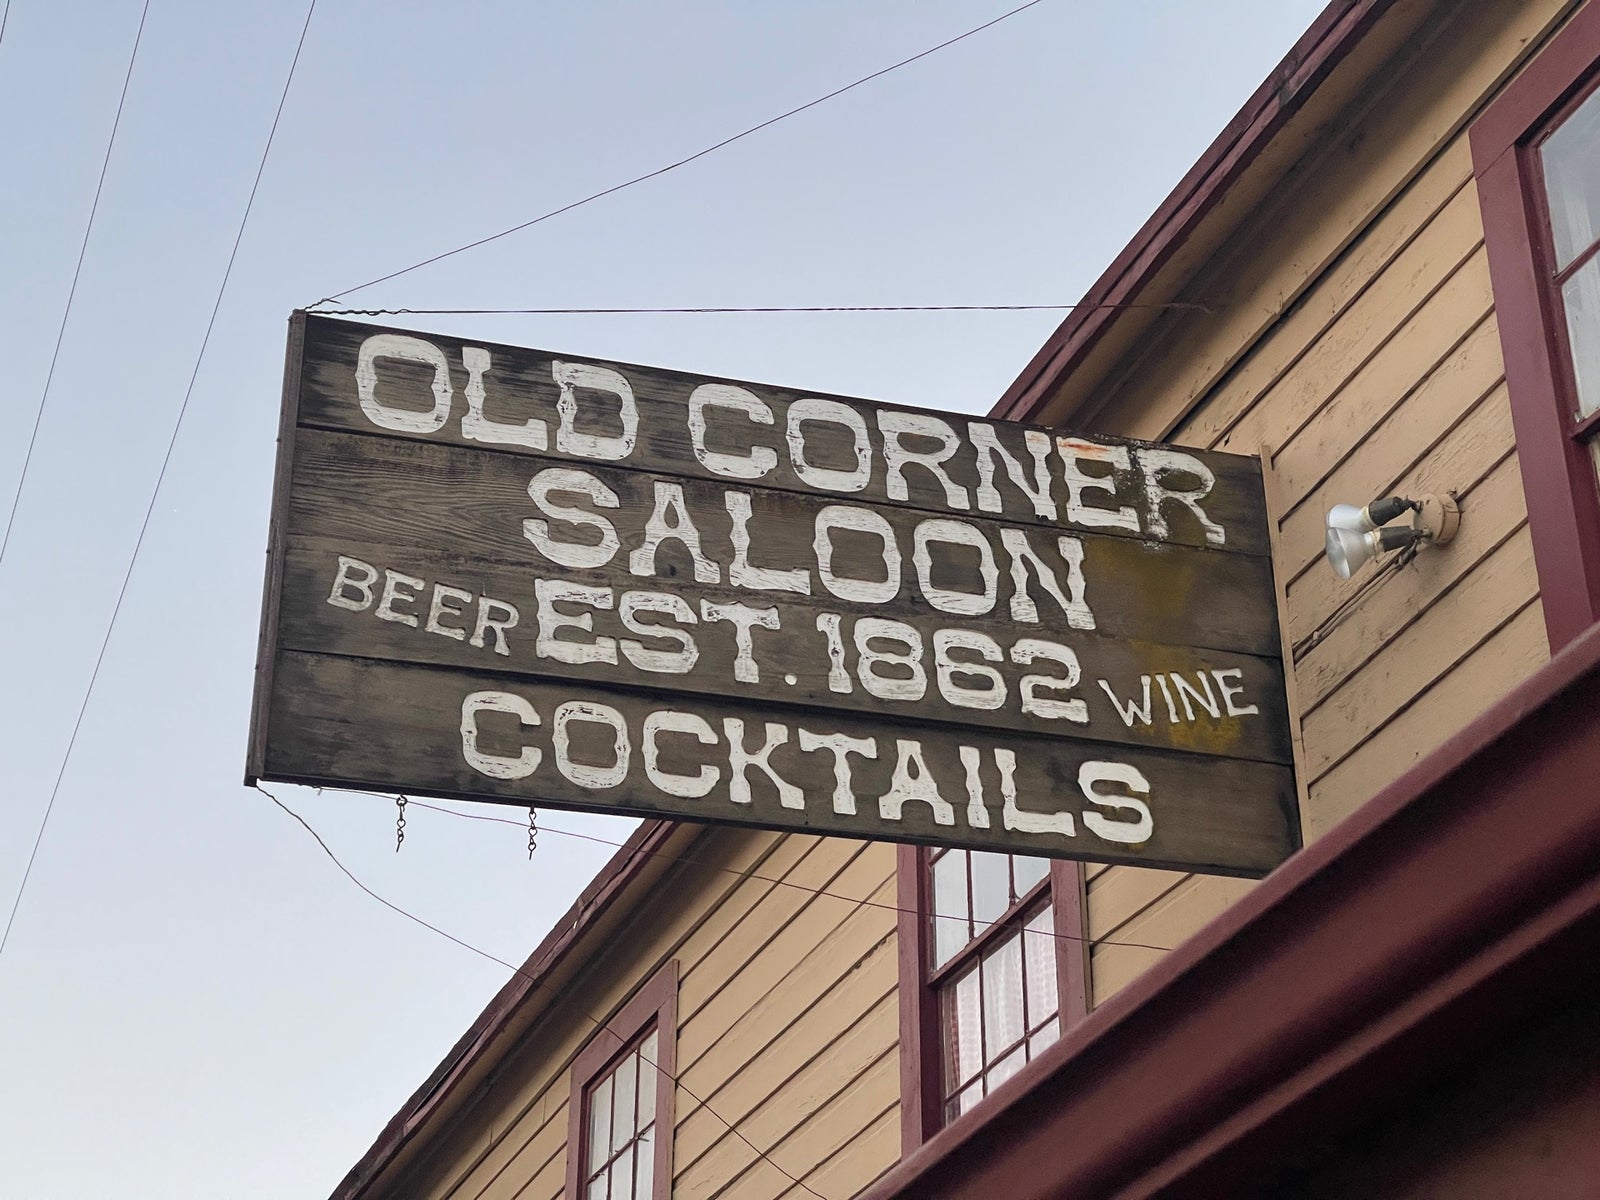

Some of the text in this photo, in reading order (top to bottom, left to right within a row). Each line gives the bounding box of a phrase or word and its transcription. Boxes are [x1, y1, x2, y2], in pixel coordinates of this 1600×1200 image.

[354, 334, 1227, 546] OLD CORNER
[326, 555, 521, 657] BEER
[522, 467, 1097, 631] SALOON
[534, 578, 1091, 724] EST. 1862
[1097, 668, 1260, 728] WINE
[460, 690, 1155, 844] COCKTAILS
